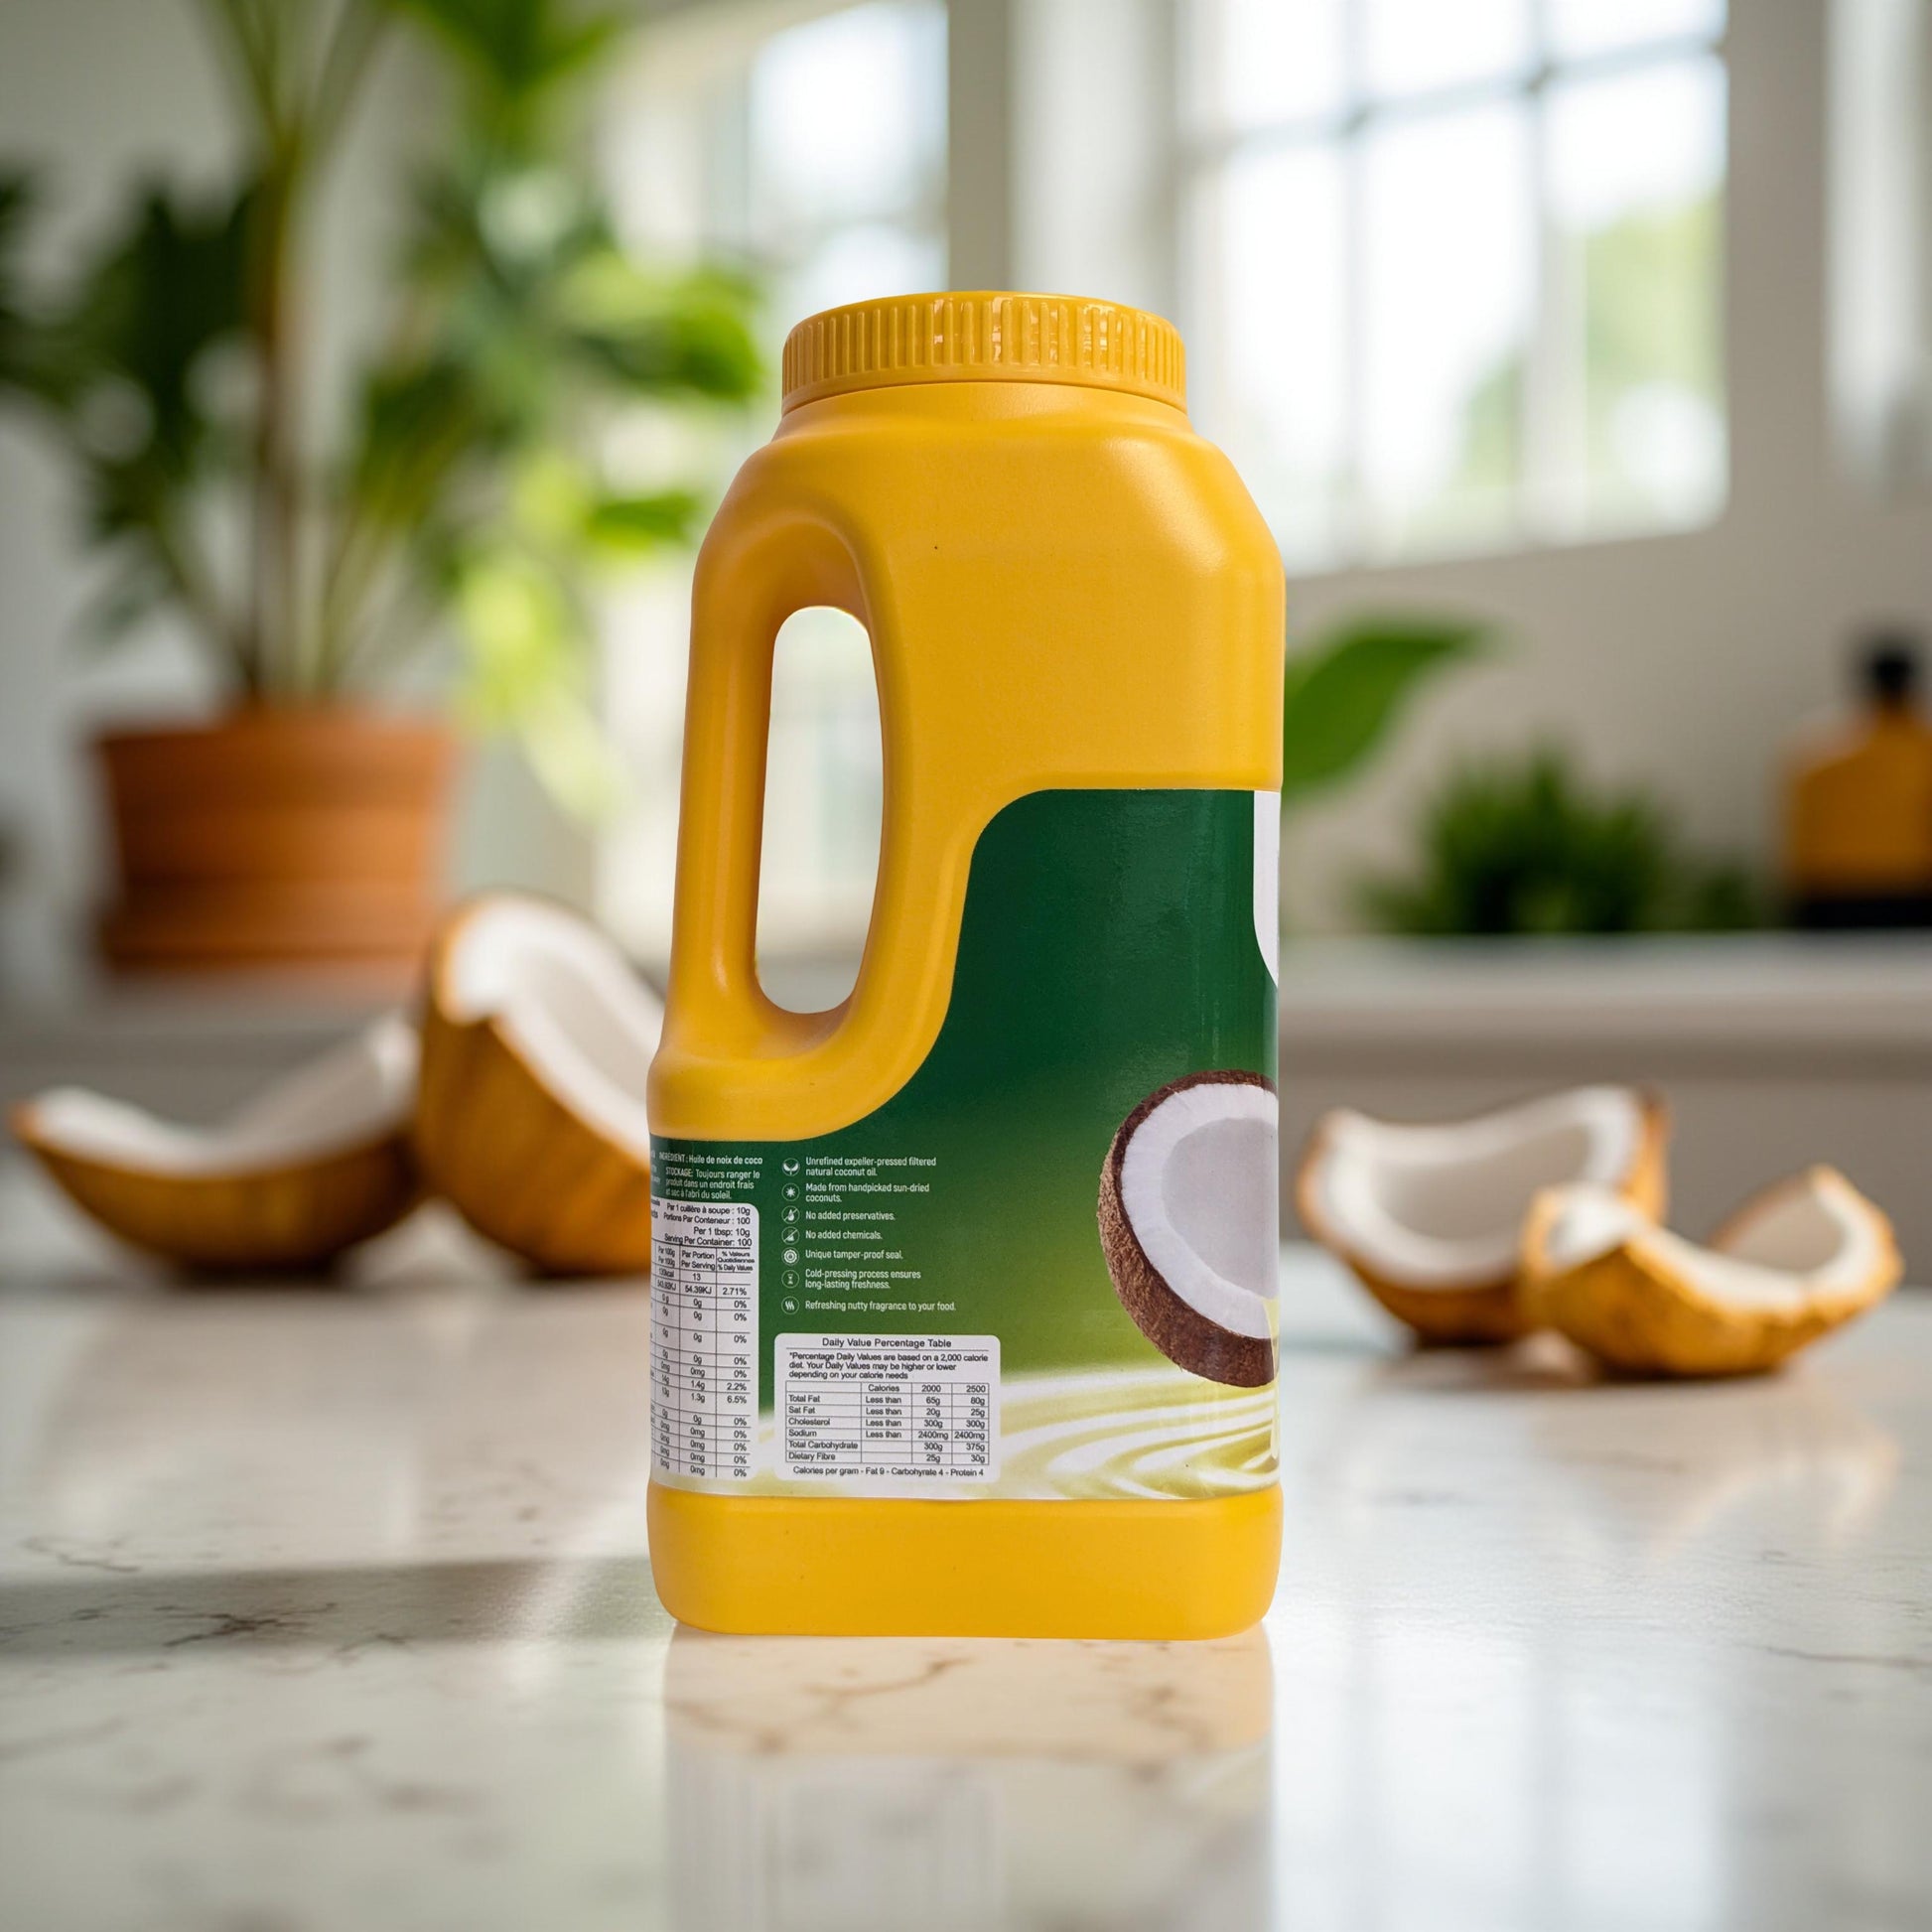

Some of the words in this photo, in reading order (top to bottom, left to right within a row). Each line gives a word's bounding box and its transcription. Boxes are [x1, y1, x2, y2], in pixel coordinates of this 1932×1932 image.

[806, 1157, 843, 1166] Unrefined
[845, 1158, 907, 1167] expeller-pressed
[909, 1157, 936, 1166] filtered
[696, 1170, 725, 1178] Toujours
[806, 1182, 827, 1191] Made
[849, 1183, 892, 1193] handpicked
[818, 1211, 841, 1220] added
[715, 1227, 733, 1237] tbsp:
[818, 1230, 841, 1239] added
[697, 1237, 735, 1246] Container:
[806, 1250, 832, 1259] Unique
[834, 1250, 884, 1260] tamper-proof
[806, 1269, 857, 1279] Cold-pressing
[806, 1281, 850, 1290] long-lasting
[806, 1301, 846, 1311] Refreshing
[848, 1302, 868, 1311] nutty
[870, 1302, 906, 1311] fragrance
[918, 1303, 935, 1311] your
[937, 1302, 955, 1311] food.
[822, 1338, 844, 1347] Daily
[875, 1339, 925, 1348] Percentage
[836, 1353, 855, 1362] Daily
[971, 1397, 985, 1406] 80g
[971, 1409, 985, 1418] 25g
[966, 1420, 985, 1429] 300g
[971, 1454, 985, 1463] 30g
